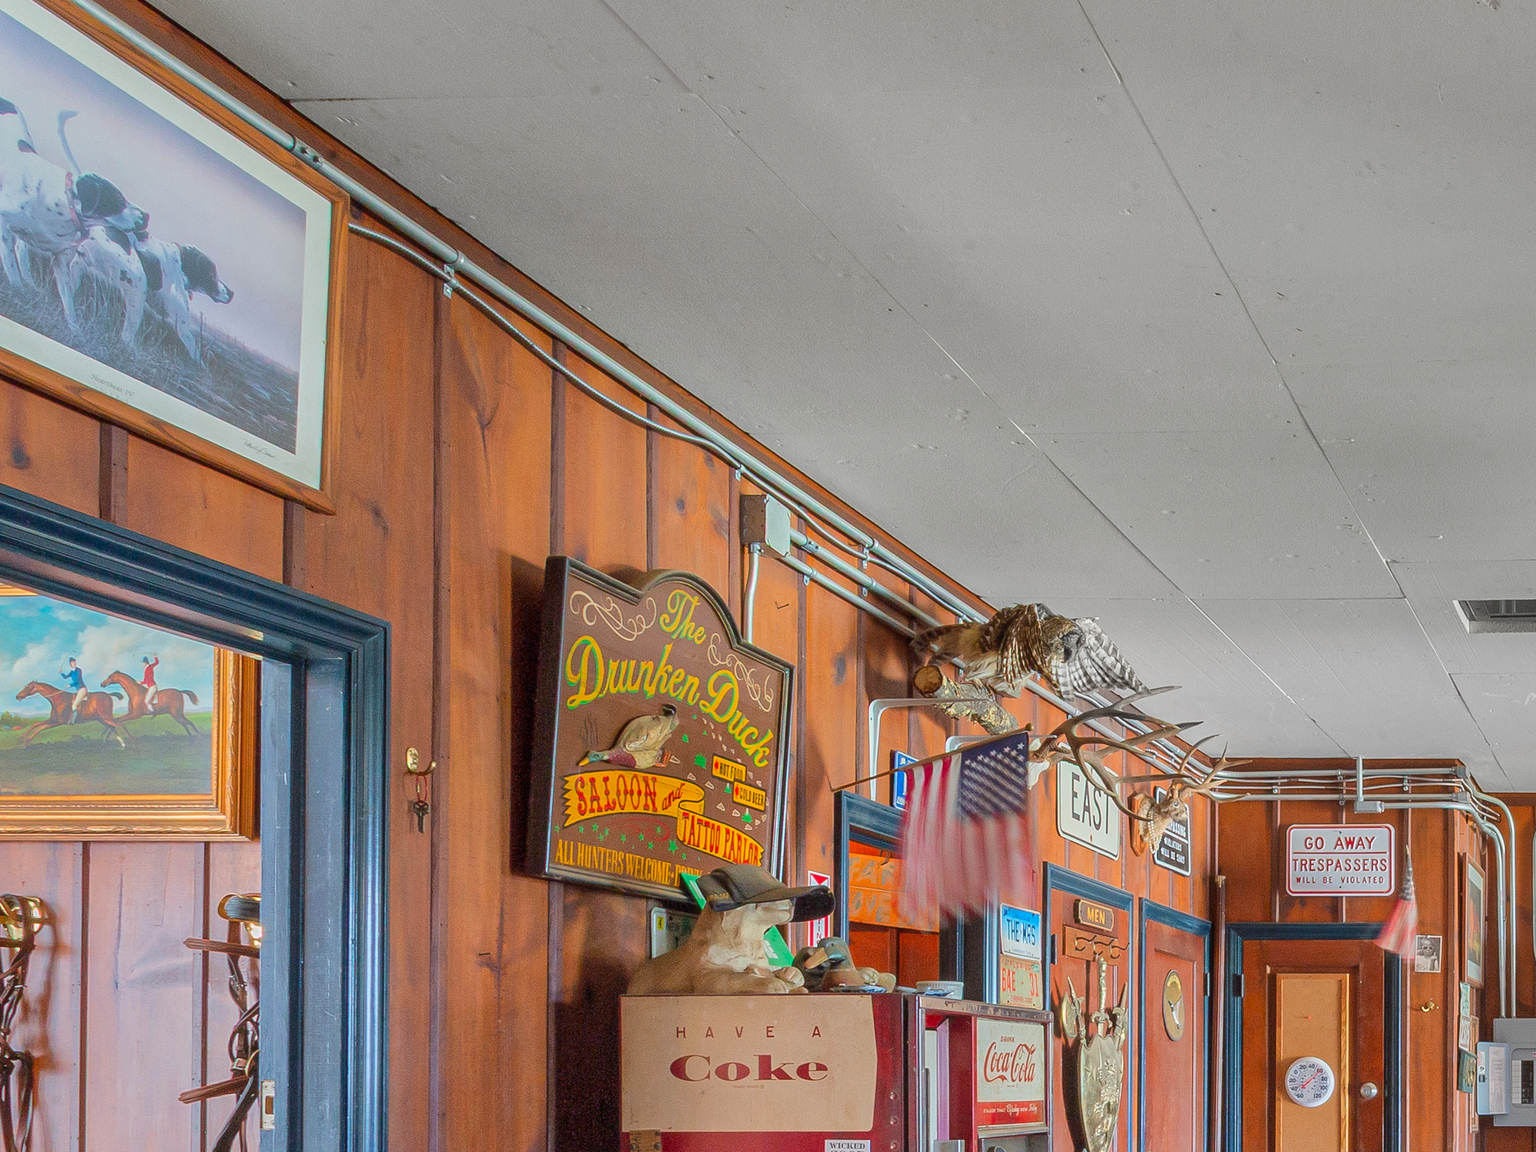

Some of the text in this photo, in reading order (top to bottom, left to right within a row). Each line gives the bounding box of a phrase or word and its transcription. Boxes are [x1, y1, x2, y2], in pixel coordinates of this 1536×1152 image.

[659, 589, 707, 645] The
[565, 635, 774, 768] Drunken Duck
[575, 774, 686, 816] SALOON and
[740, 787, 764, 806] COLD BEER
[1072, 772, 1111, 835] EAST
[682, 812, 759, 866] TATTOO PARLOR
[1304, 836, 1376, 850] GO AWAY
[555, 839, 575, 866] ALL
[577, 842, 624, 875] HUNTERS
[626, 853, 671, 886] WELCOME
[1292, 859, 1388, 872] TRESPASSERS
[1296, 876, 1384, 884] WILL BE VIOLATED
[1086, 906, 1105, 925] MEN
[676, 1025, 822, 1039] HAVE A
[669, 1054, 828, 1082] Coke
[829, 1142, 866, 1150] WICKED
